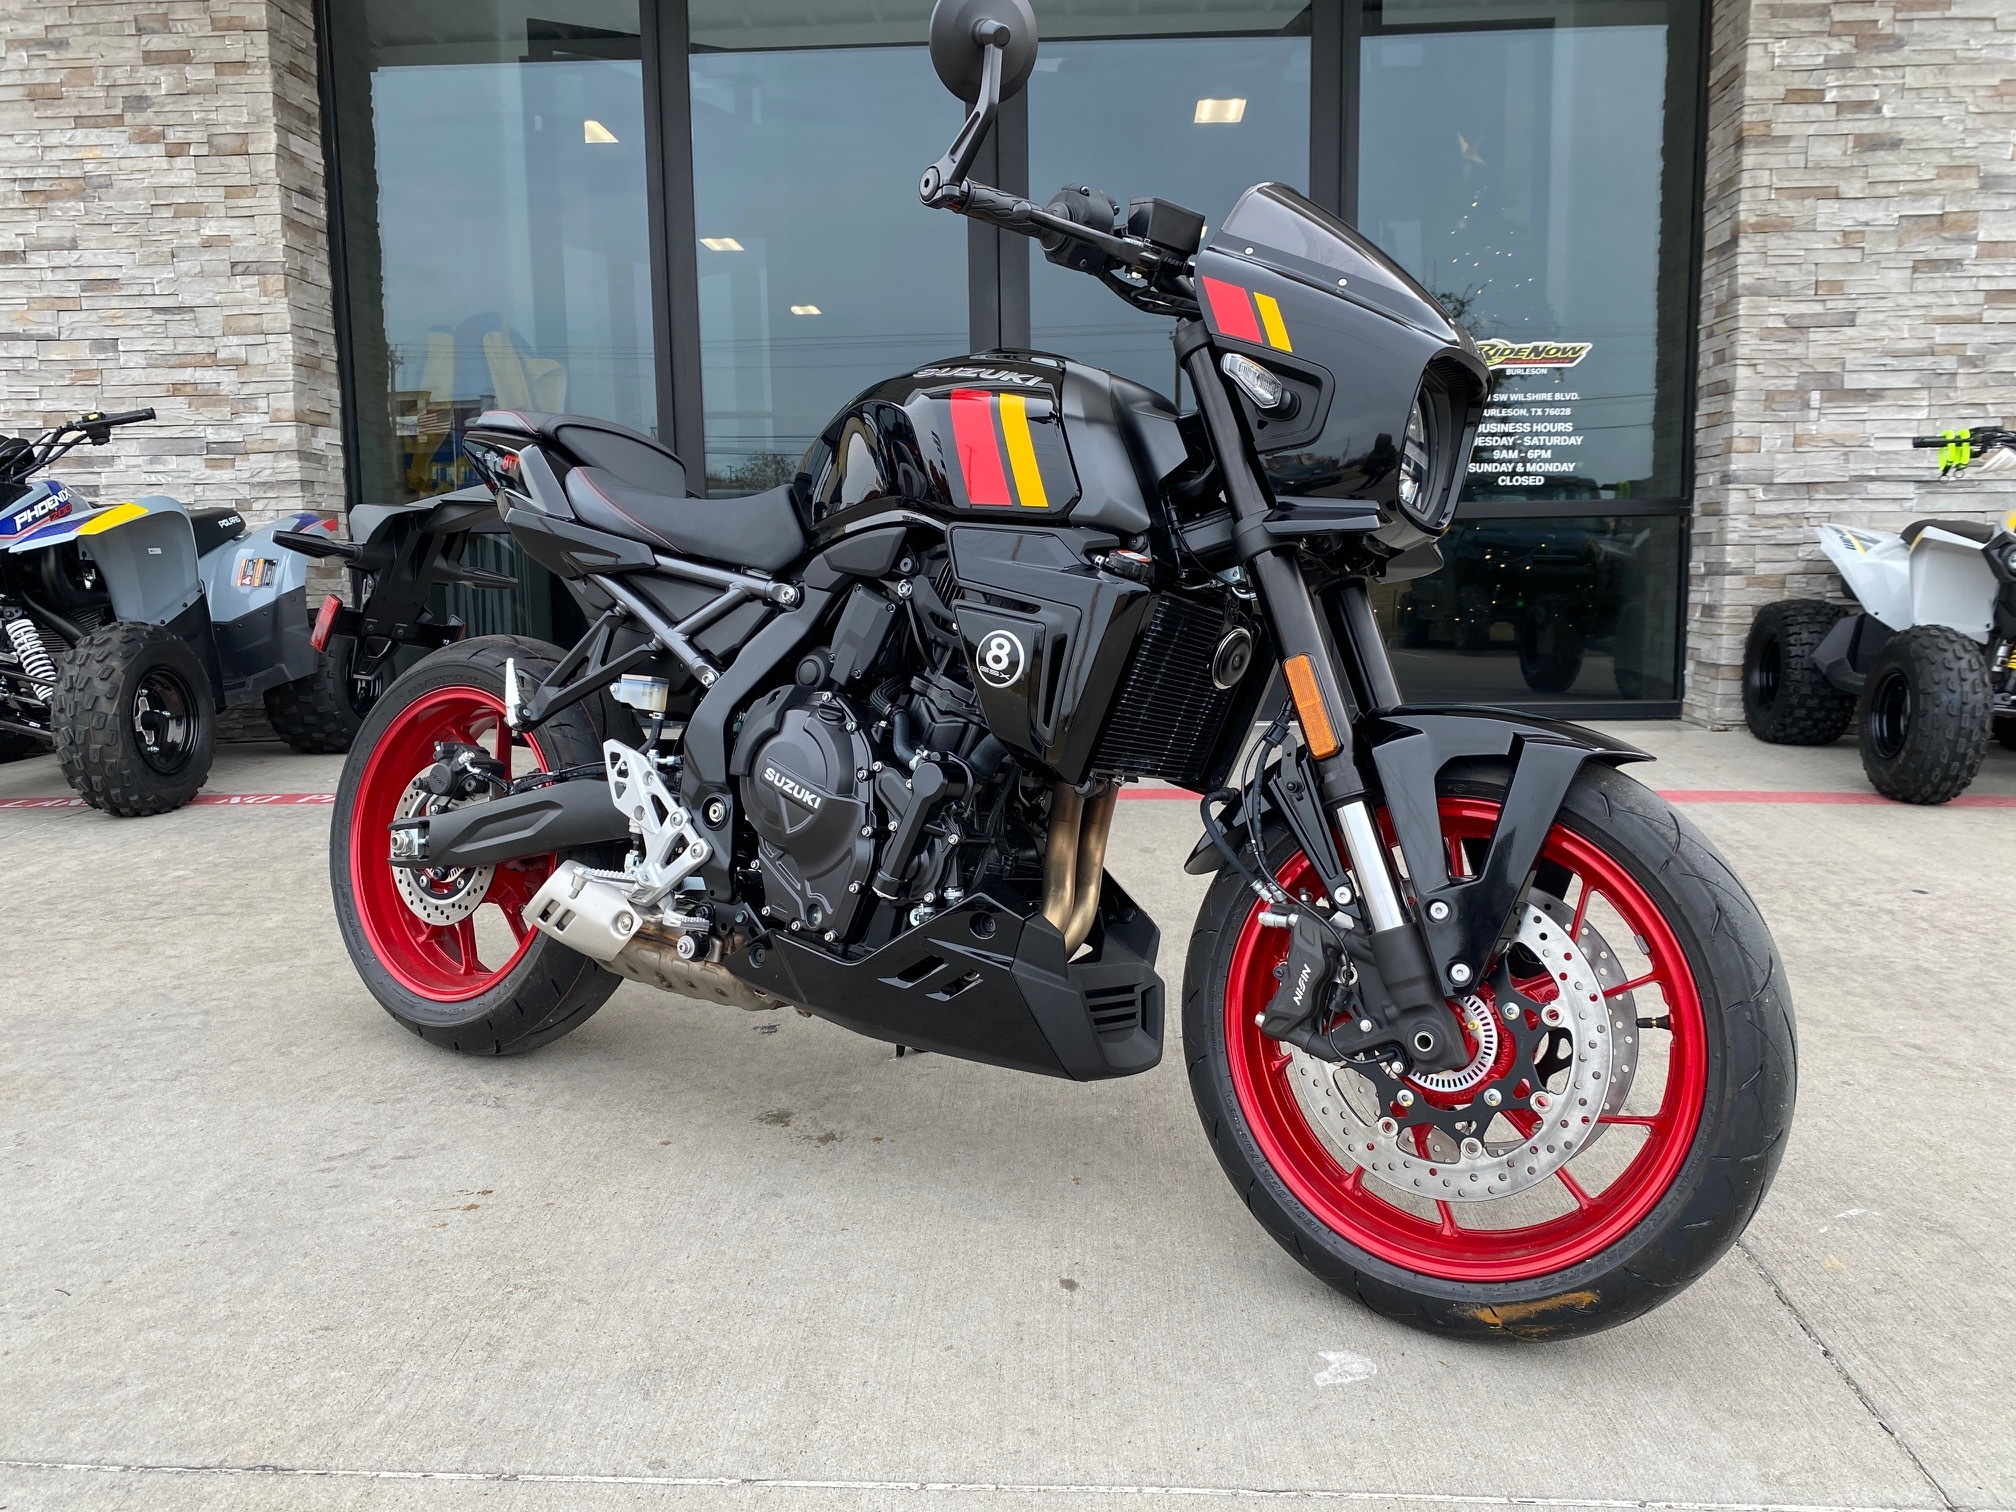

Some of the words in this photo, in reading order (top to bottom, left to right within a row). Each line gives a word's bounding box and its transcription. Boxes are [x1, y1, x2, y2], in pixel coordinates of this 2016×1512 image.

[912, 367, 1044, 387] SUZUKI
[1493, 393, 1509, 402] SW
[1509, 393, 1553, 402] WILSHIRE
[1554, 392, 1580, 401] BLVD.
[1482, 408, 1529, 417] URLESON,
[1530, 408, 1542, 416] TX
[1544, 407, 1571, 416] 76028
[1533, 422, 1573, 432] HOURS
[1523, 436, 1584, 446] SATURDAY
[1493, 449, 1519, 459] 9AM
[1527, 449, 1551, 459] 6PM
[1468, 462, 1515, 472] SUNDAY
[1516, 462, 1525, 473] &
[1526, 462, 1576, 472] MONDAY
[1497, 475, 1545, 486] CLOSED
[13, 488, 72, 532] PHOENIX
[49, 502, 73, 522] 200
[217, 515, 241, 529] POLARIS
[985, 636, 1011, 671] 8
[979, 665, 1011, 680] GSX
[763, 767, 822, 810] SUZUKI
